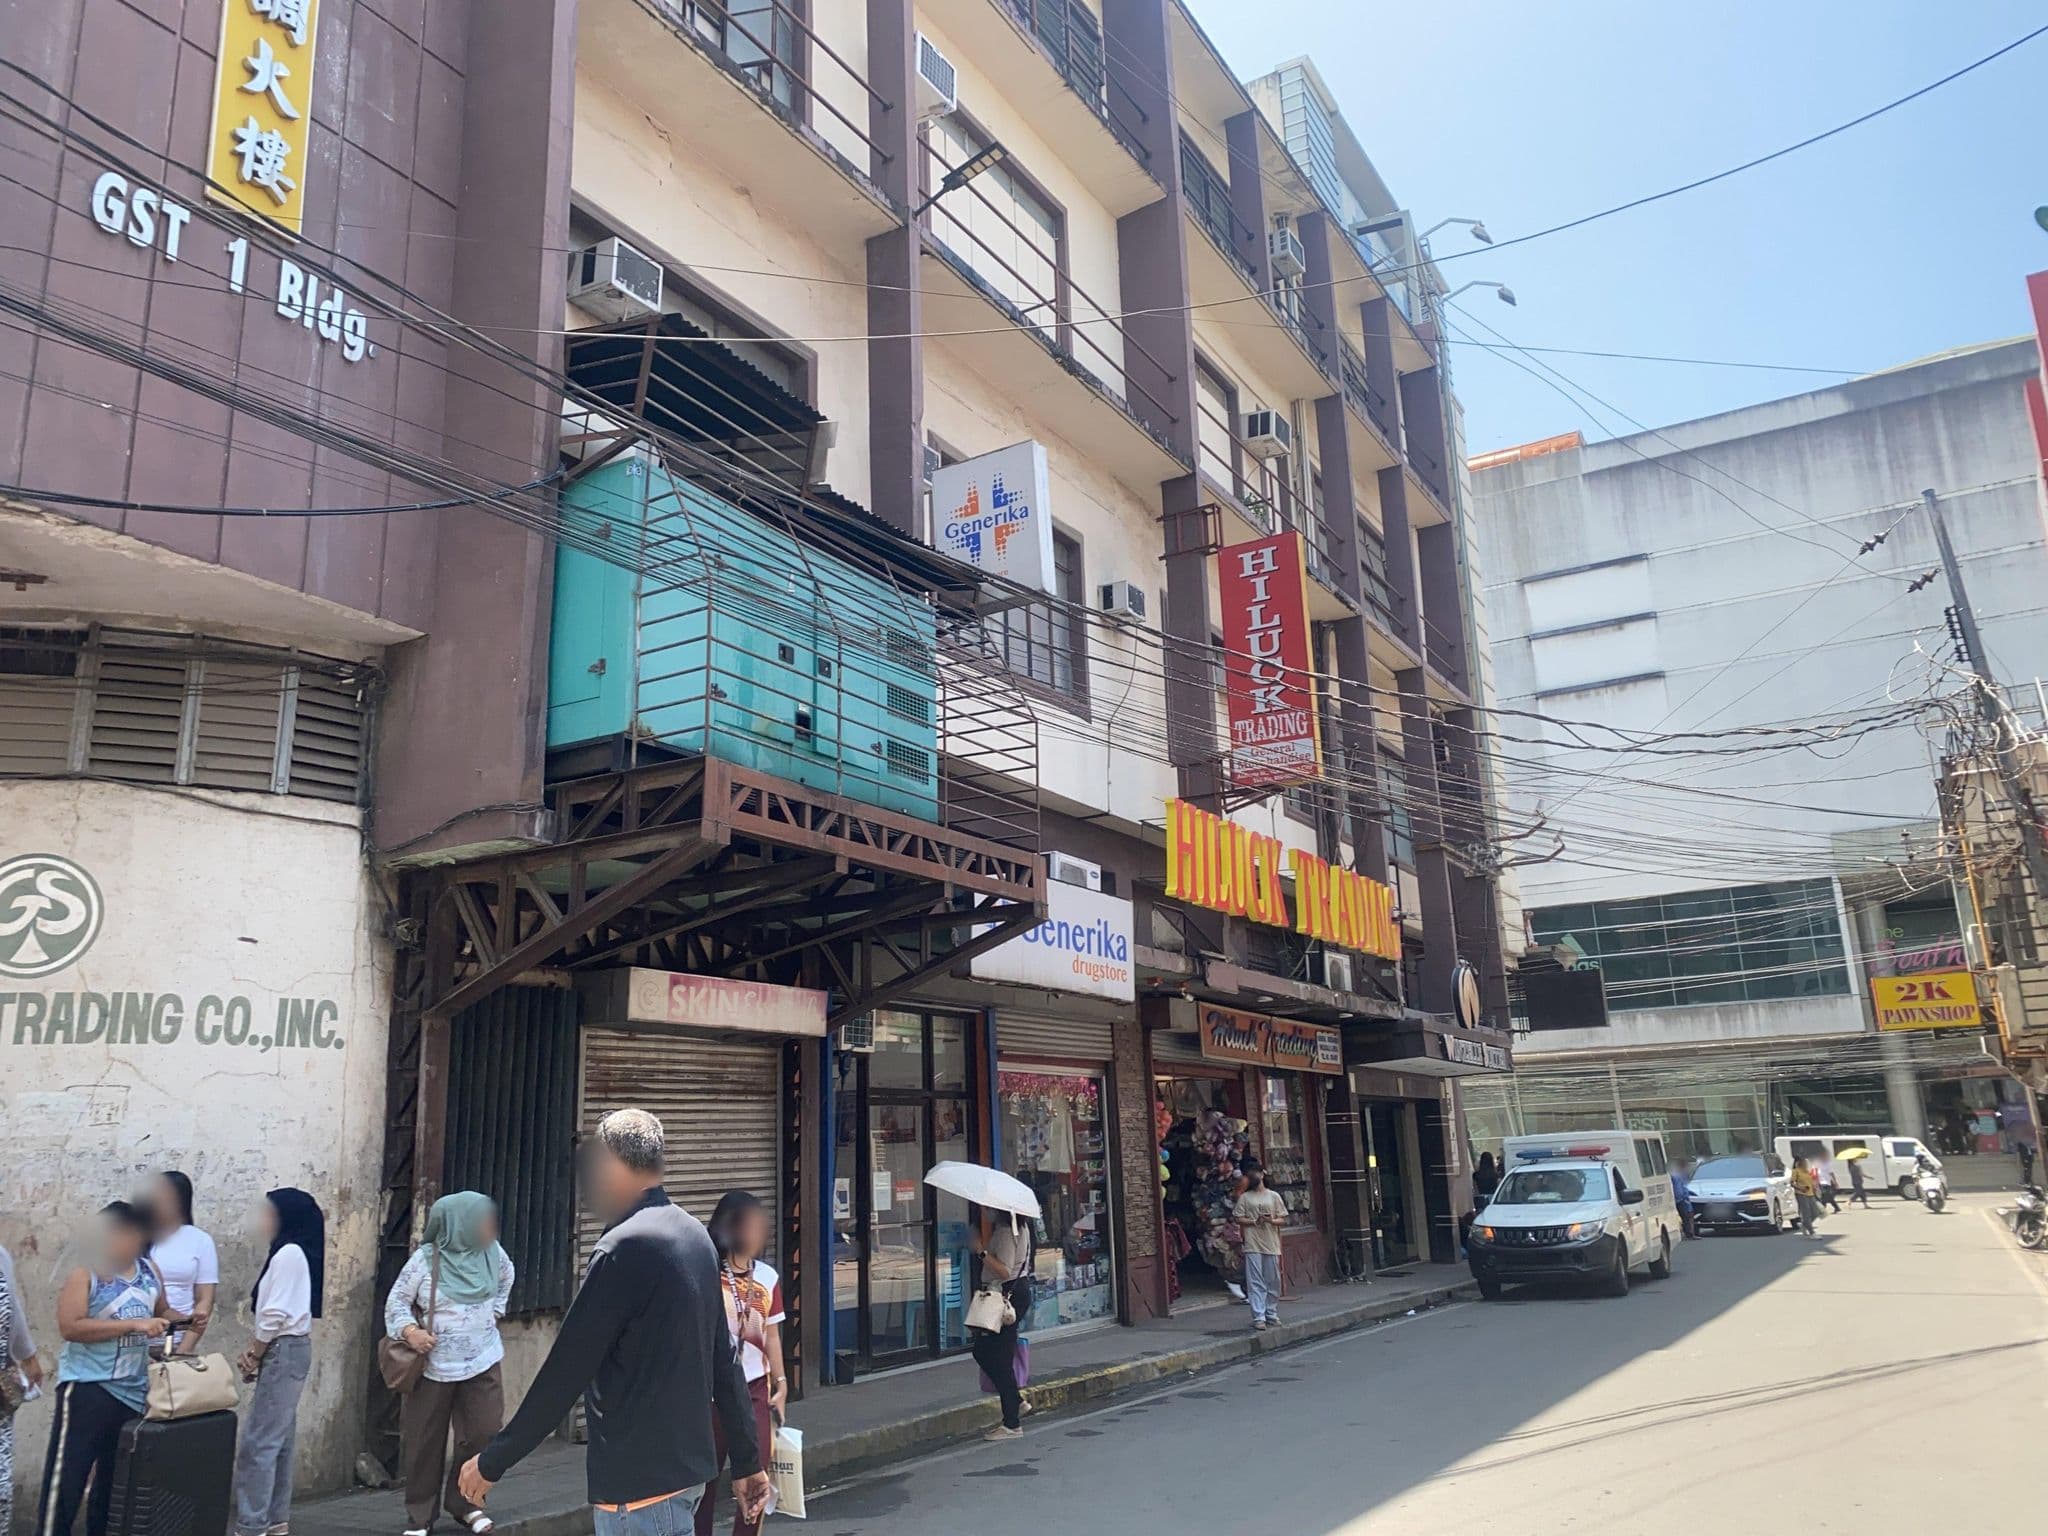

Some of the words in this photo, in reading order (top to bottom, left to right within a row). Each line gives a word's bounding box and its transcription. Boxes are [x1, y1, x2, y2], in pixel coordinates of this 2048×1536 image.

[92, 171, 190, 262] GST
[226, 236, 248, 293] 1
[277, 259, 377, 362] Bldg.
[945, 505, 1029, 539] Generika
[1238, 546, 1291, 715] HILUCK
[1235, 711, 1308, 743] TRADING
[1165, 798, 1289, 928] HILUCK
[1288, 848, 1402, 960] TRADING
[1072, 954, 1128, 983] drugstore
[1895, 981, 1954, 1002] 2K
[1883, 1004, 1976, 1025] PAWNSHOP
[1206, 1010, 1259, 1053] Hiluck
[1258, 1019, 1319, 1068] Trading
